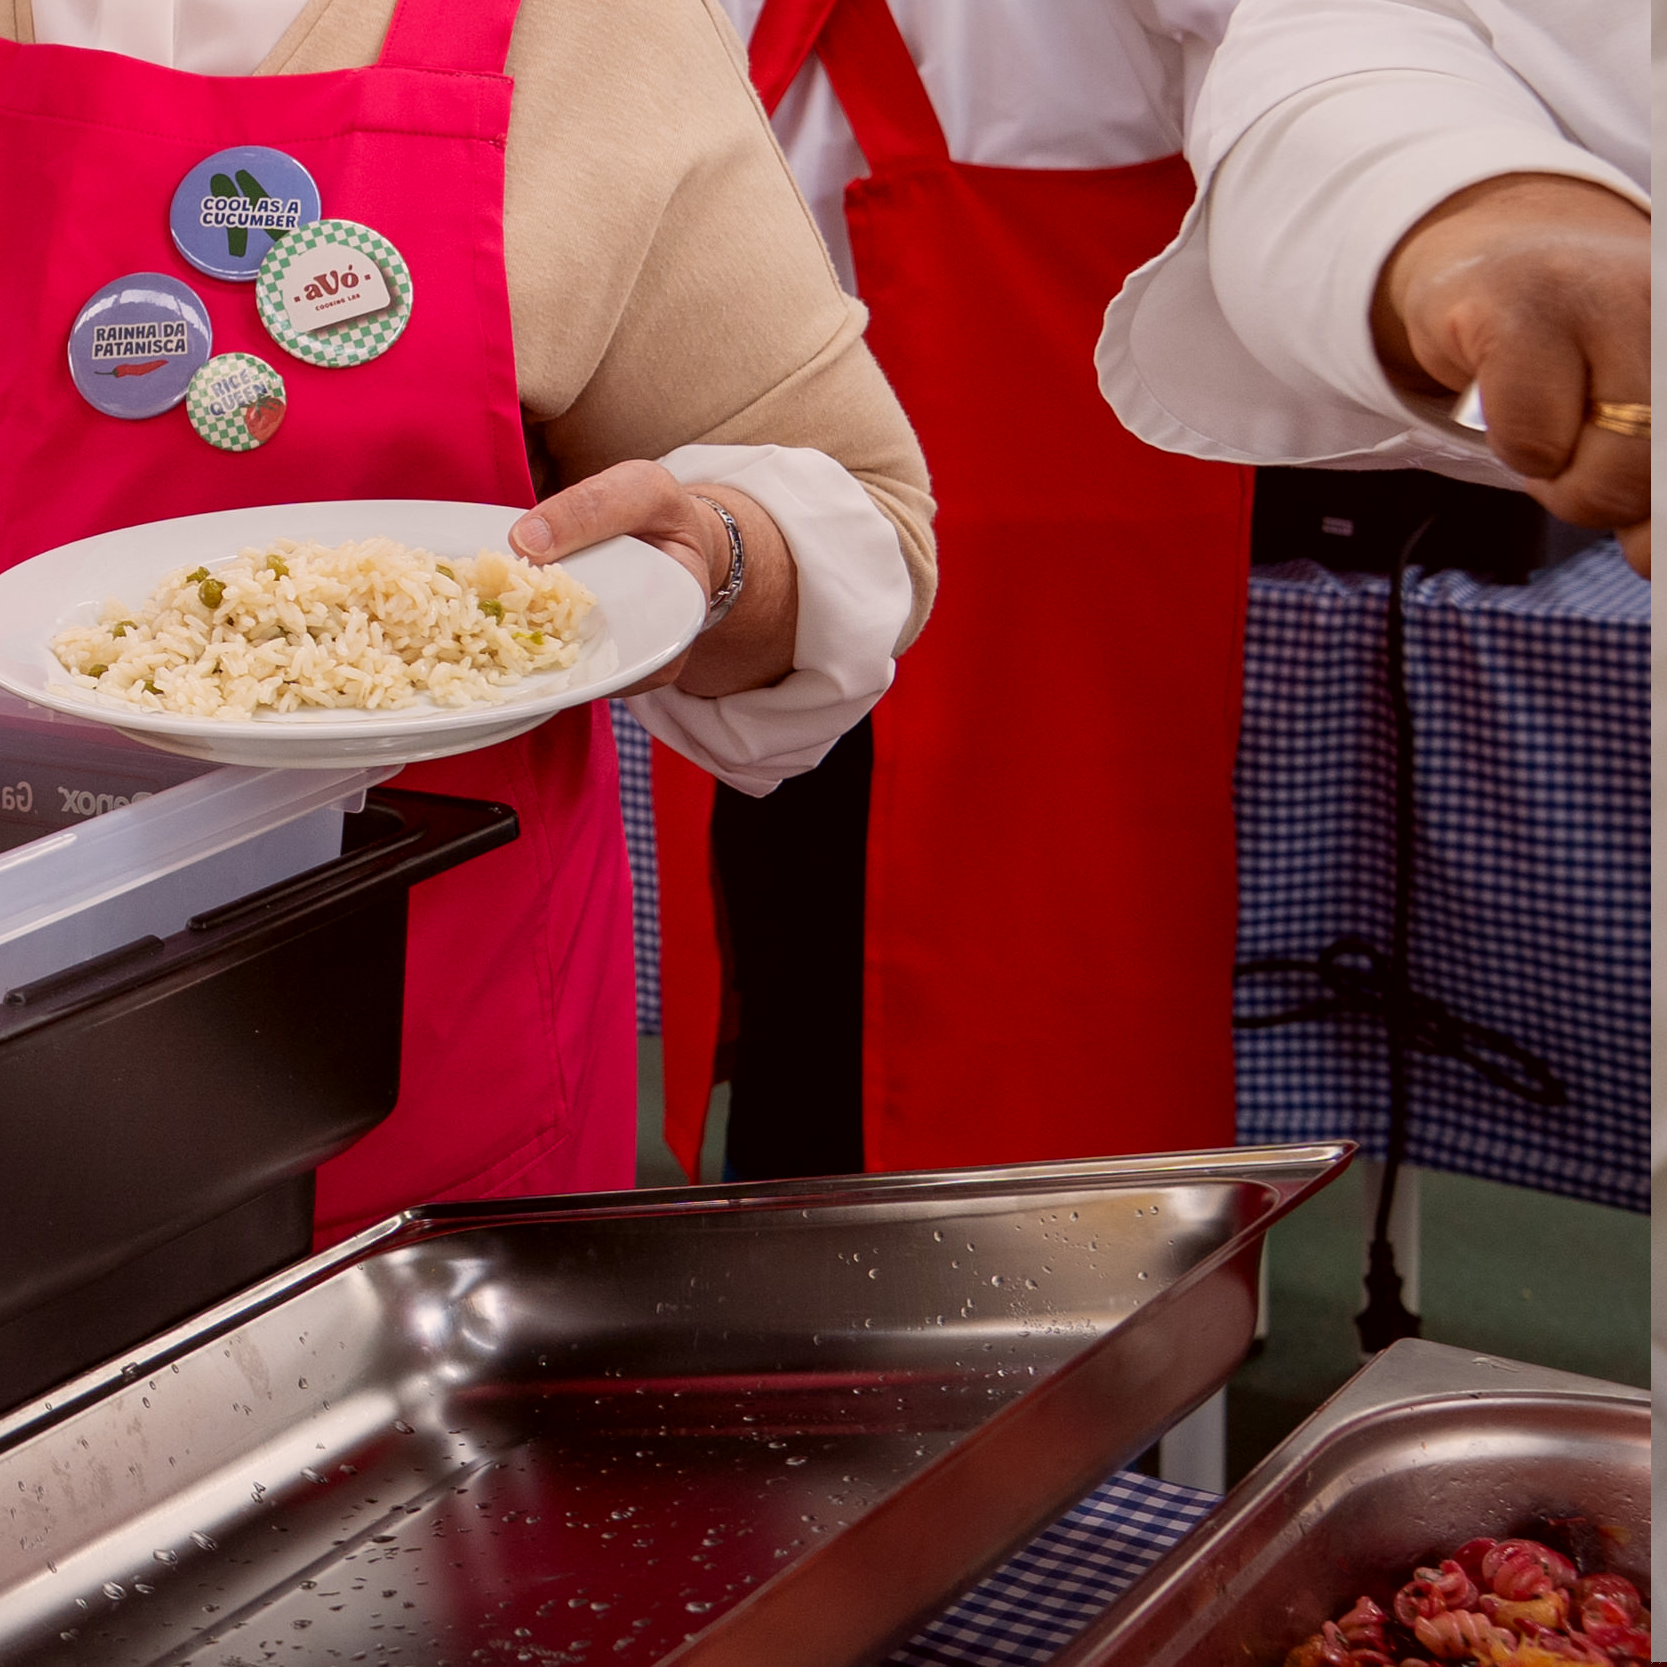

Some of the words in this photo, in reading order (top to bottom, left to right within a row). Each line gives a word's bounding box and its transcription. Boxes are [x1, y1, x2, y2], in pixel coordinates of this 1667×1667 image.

[203, 198, 251, 212] COOL
[257, 199, 280, 213] AS
[287, 201, 299, 214] A
[202, 212, 297, 228] CUCUMBER
[315, 298, 346, 311] COOKING
[96, 324, 157, 342] RAINHA
[163, 323, 186, 338] DA
[94, 338, 186, 357] PATANISCA
[210, 381, 268, 416] QUEEN
